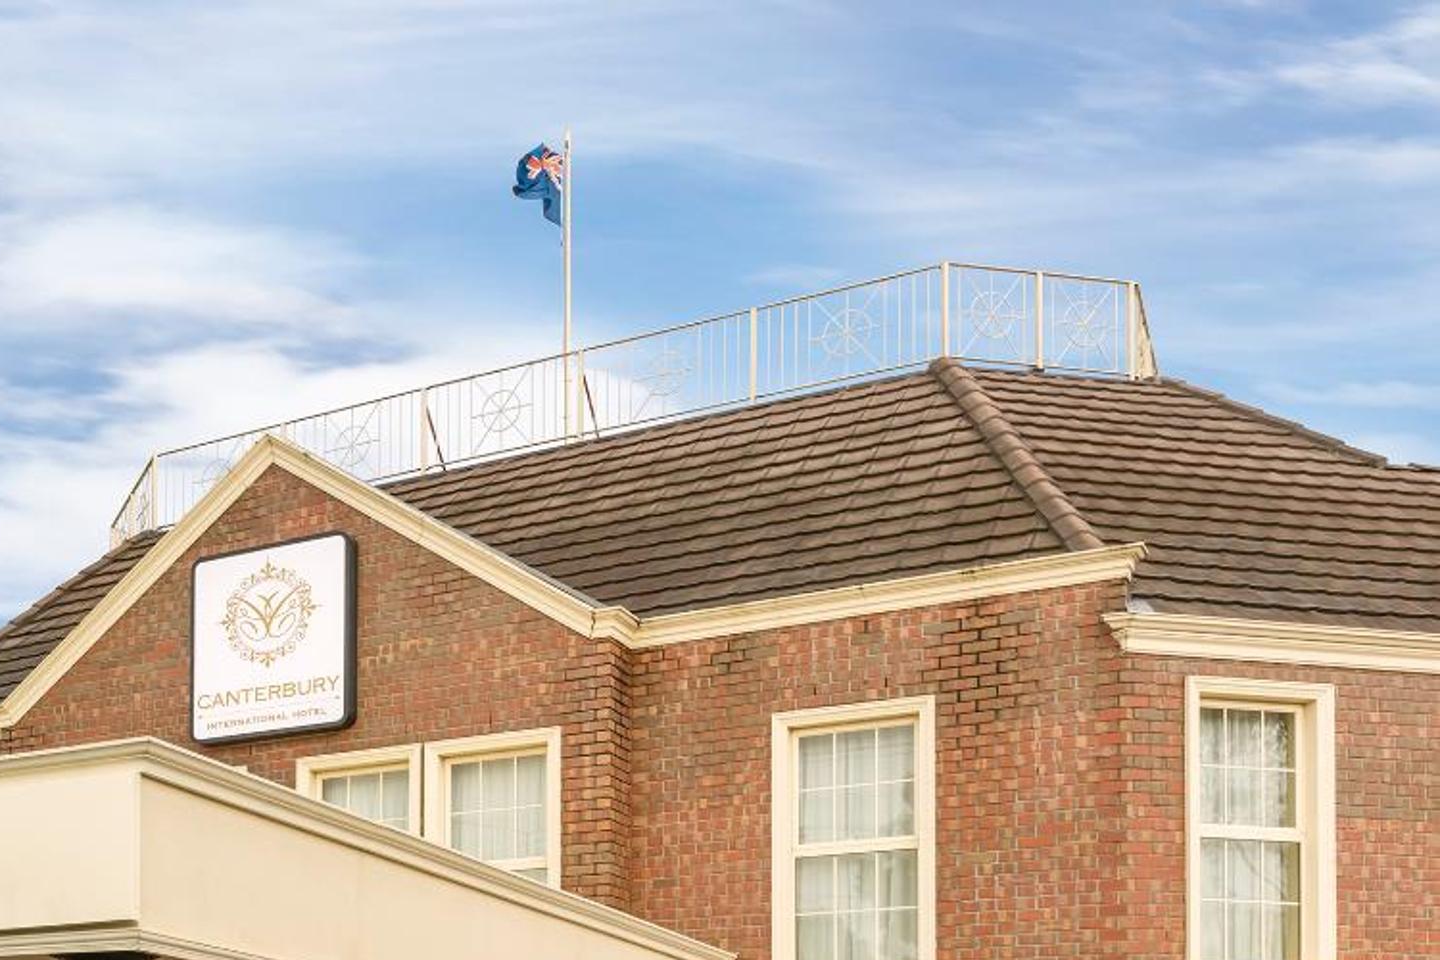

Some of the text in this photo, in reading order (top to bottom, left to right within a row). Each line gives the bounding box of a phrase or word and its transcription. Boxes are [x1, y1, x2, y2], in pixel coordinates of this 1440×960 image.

[197, 675, 339, 709] CANTERBURY
[206, 707, 327, 730] INTERNATIONAL HOTEL
